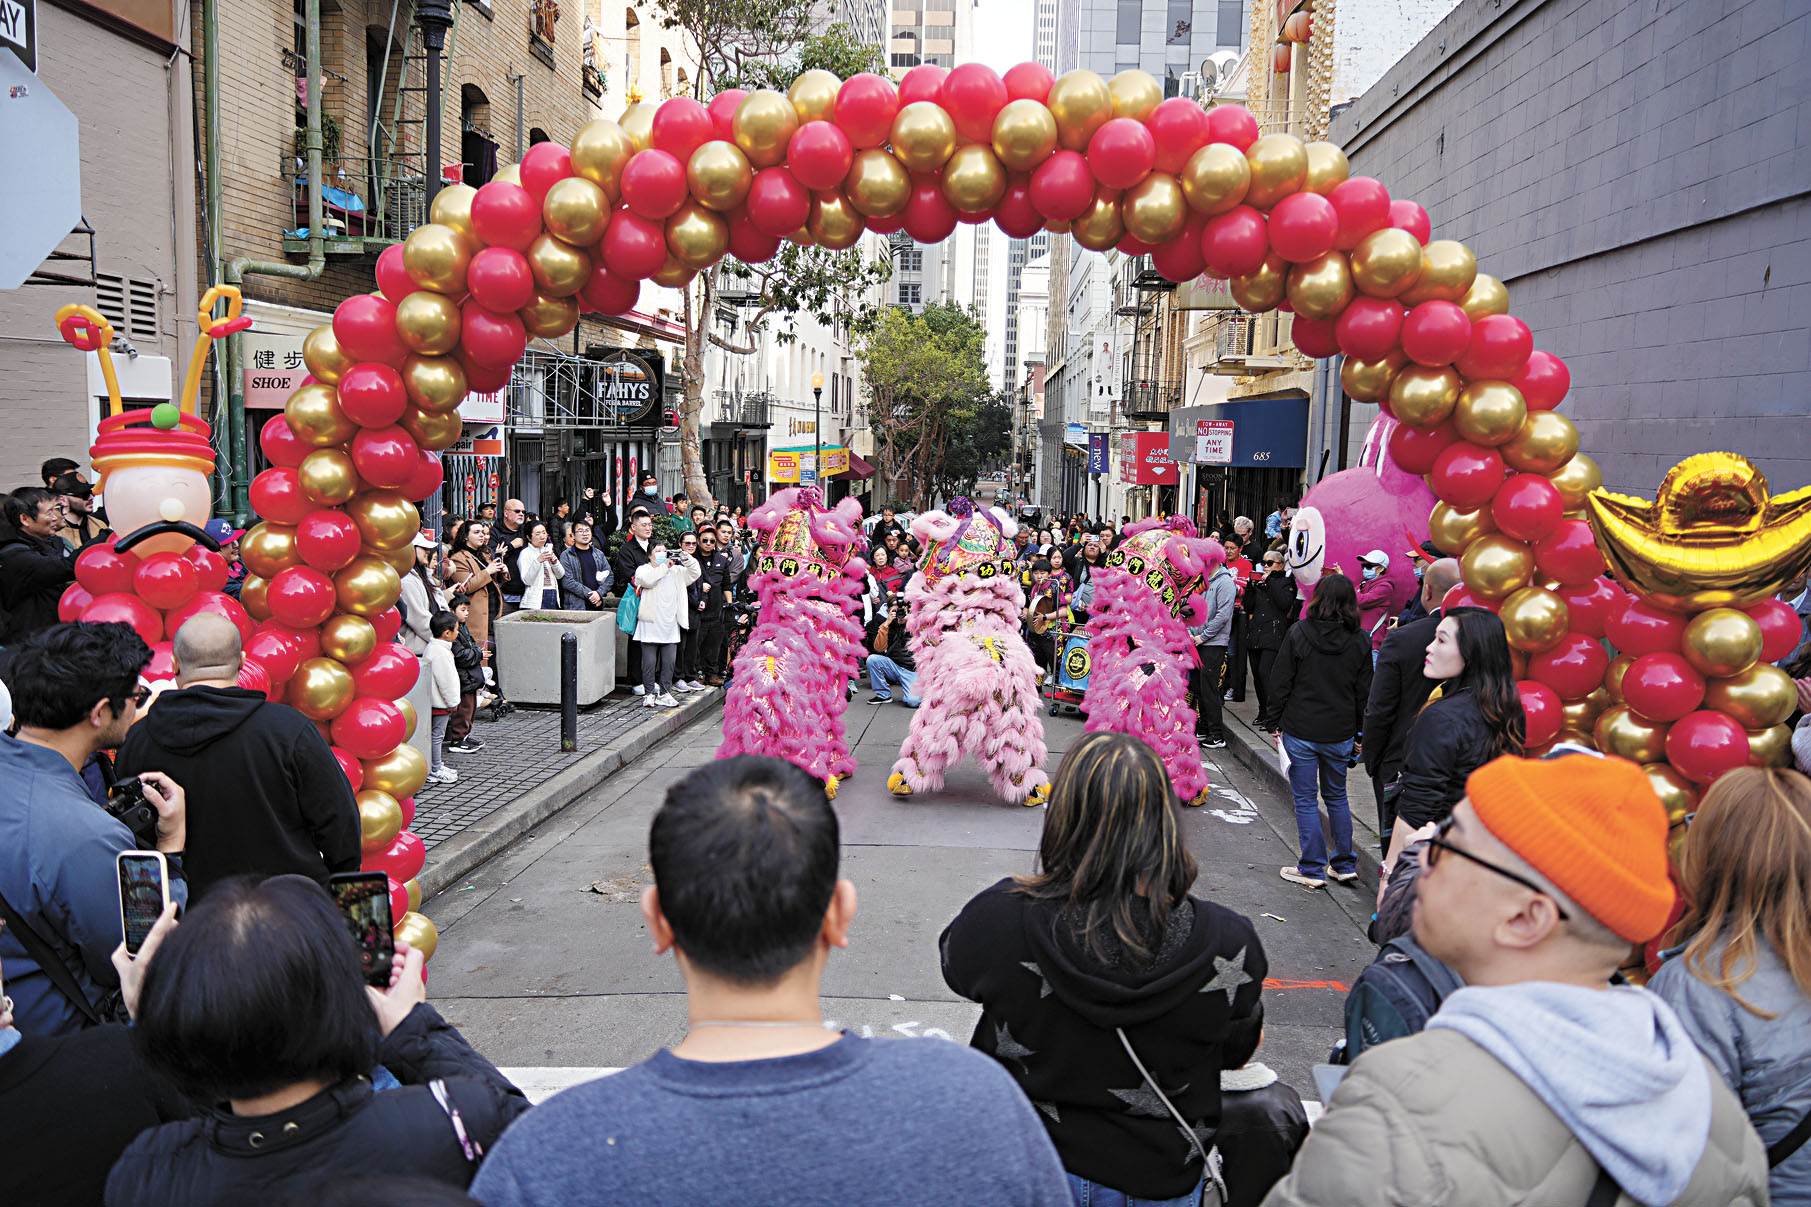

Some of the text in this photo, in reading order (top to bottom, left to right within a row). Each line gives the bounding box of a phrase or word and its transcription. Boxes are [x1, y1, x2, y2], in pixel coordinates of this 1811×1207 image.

[252, 377, 291, 389] SHOE
[598, 382, 650, 400] FAHYS
[1198, 427, 1208, 436] NO
[1209, 429, 1232, 437] STOPPING
[1205, 446, 1223, 454] TIME
[1253, 451, 1271, 461] 685
